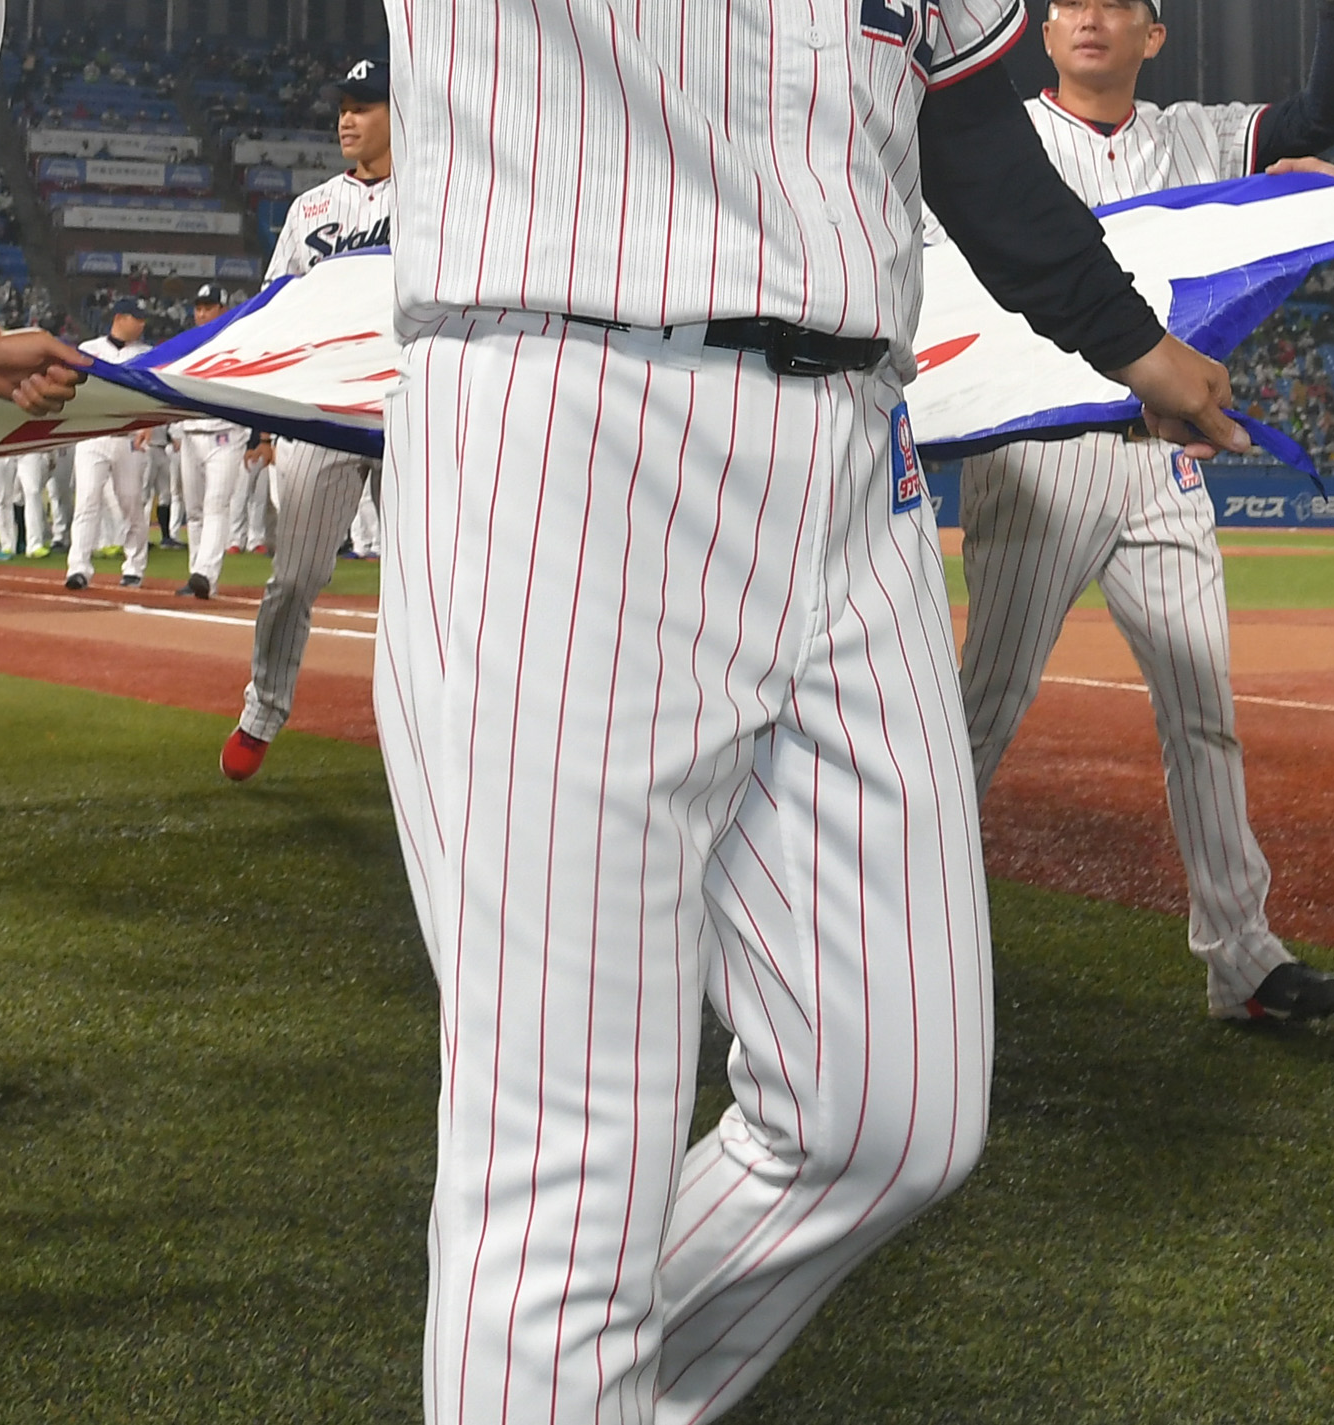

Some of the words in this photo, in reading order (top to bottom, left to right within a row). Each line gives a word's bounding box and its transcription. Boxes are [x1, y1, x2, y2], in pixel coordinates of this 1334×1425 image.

[304, 216, 390, 268] Swall
[1223, 496, 1287, 518] アセス
